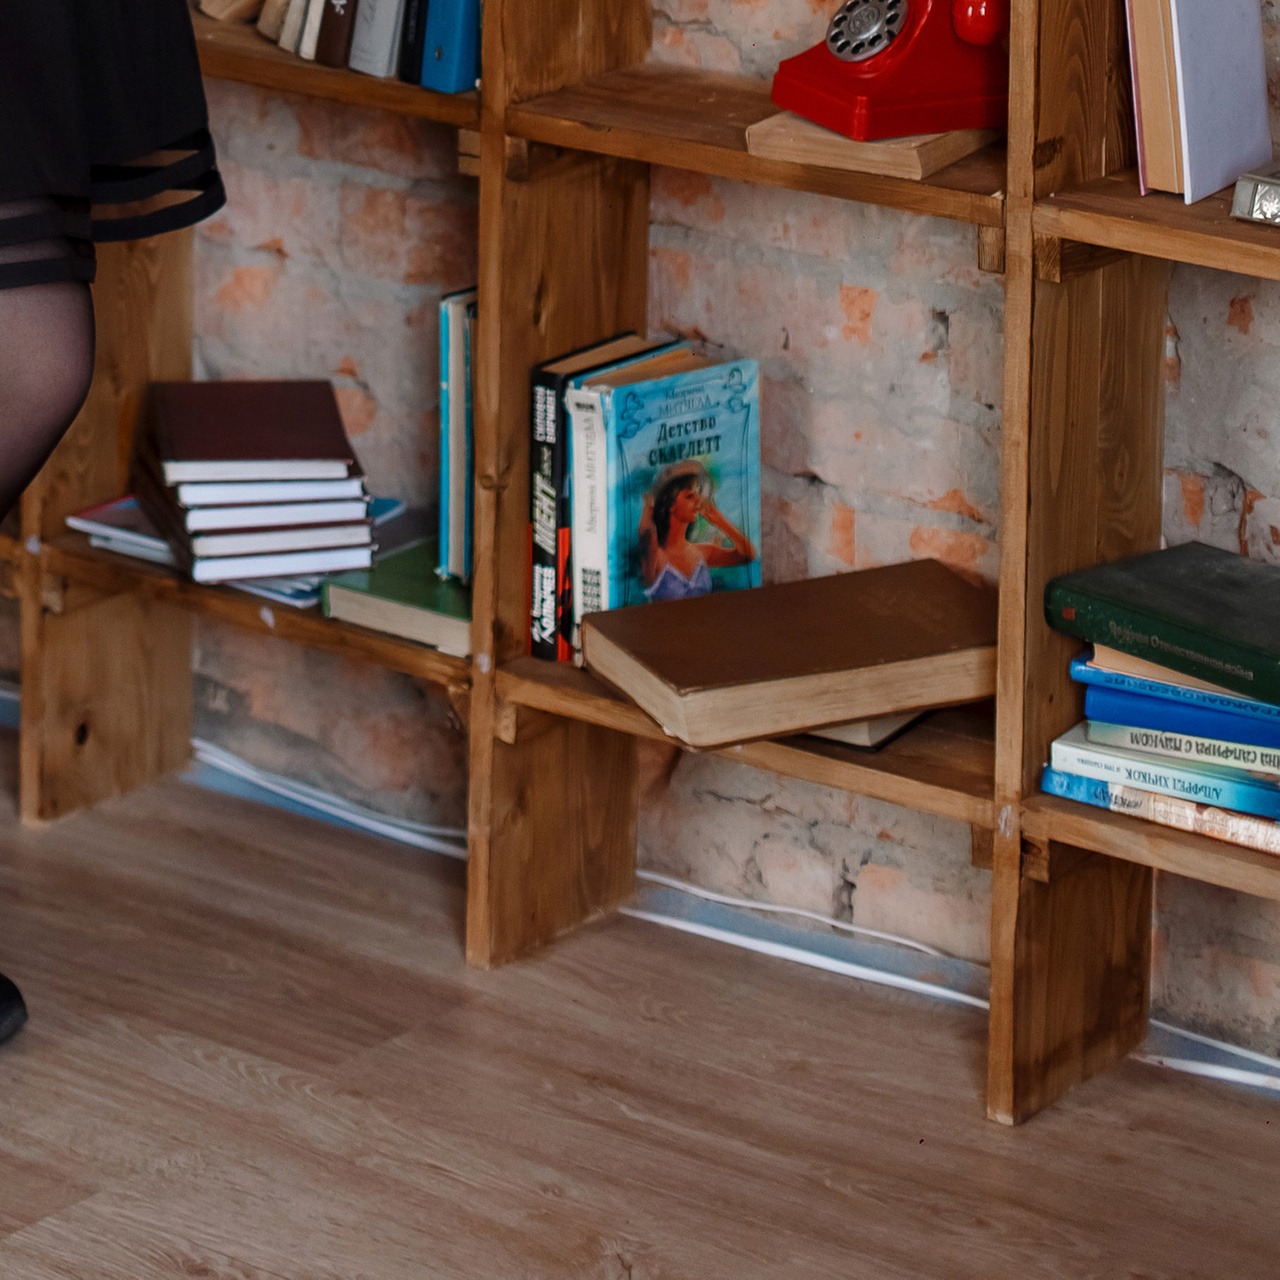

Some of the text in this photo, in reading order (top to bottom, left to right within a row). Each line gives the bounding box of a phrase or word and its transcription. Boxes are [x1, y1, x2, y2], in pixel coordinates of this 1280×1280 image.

[656, 414, 718, 446] Детство
[646, 434, 723, 469] СКАРЛЕТТ
[533, 470, 558, 555] МЕНТ
[1124, 766, 1223, 801] АЛЬФРЕД ХИЧКОК
